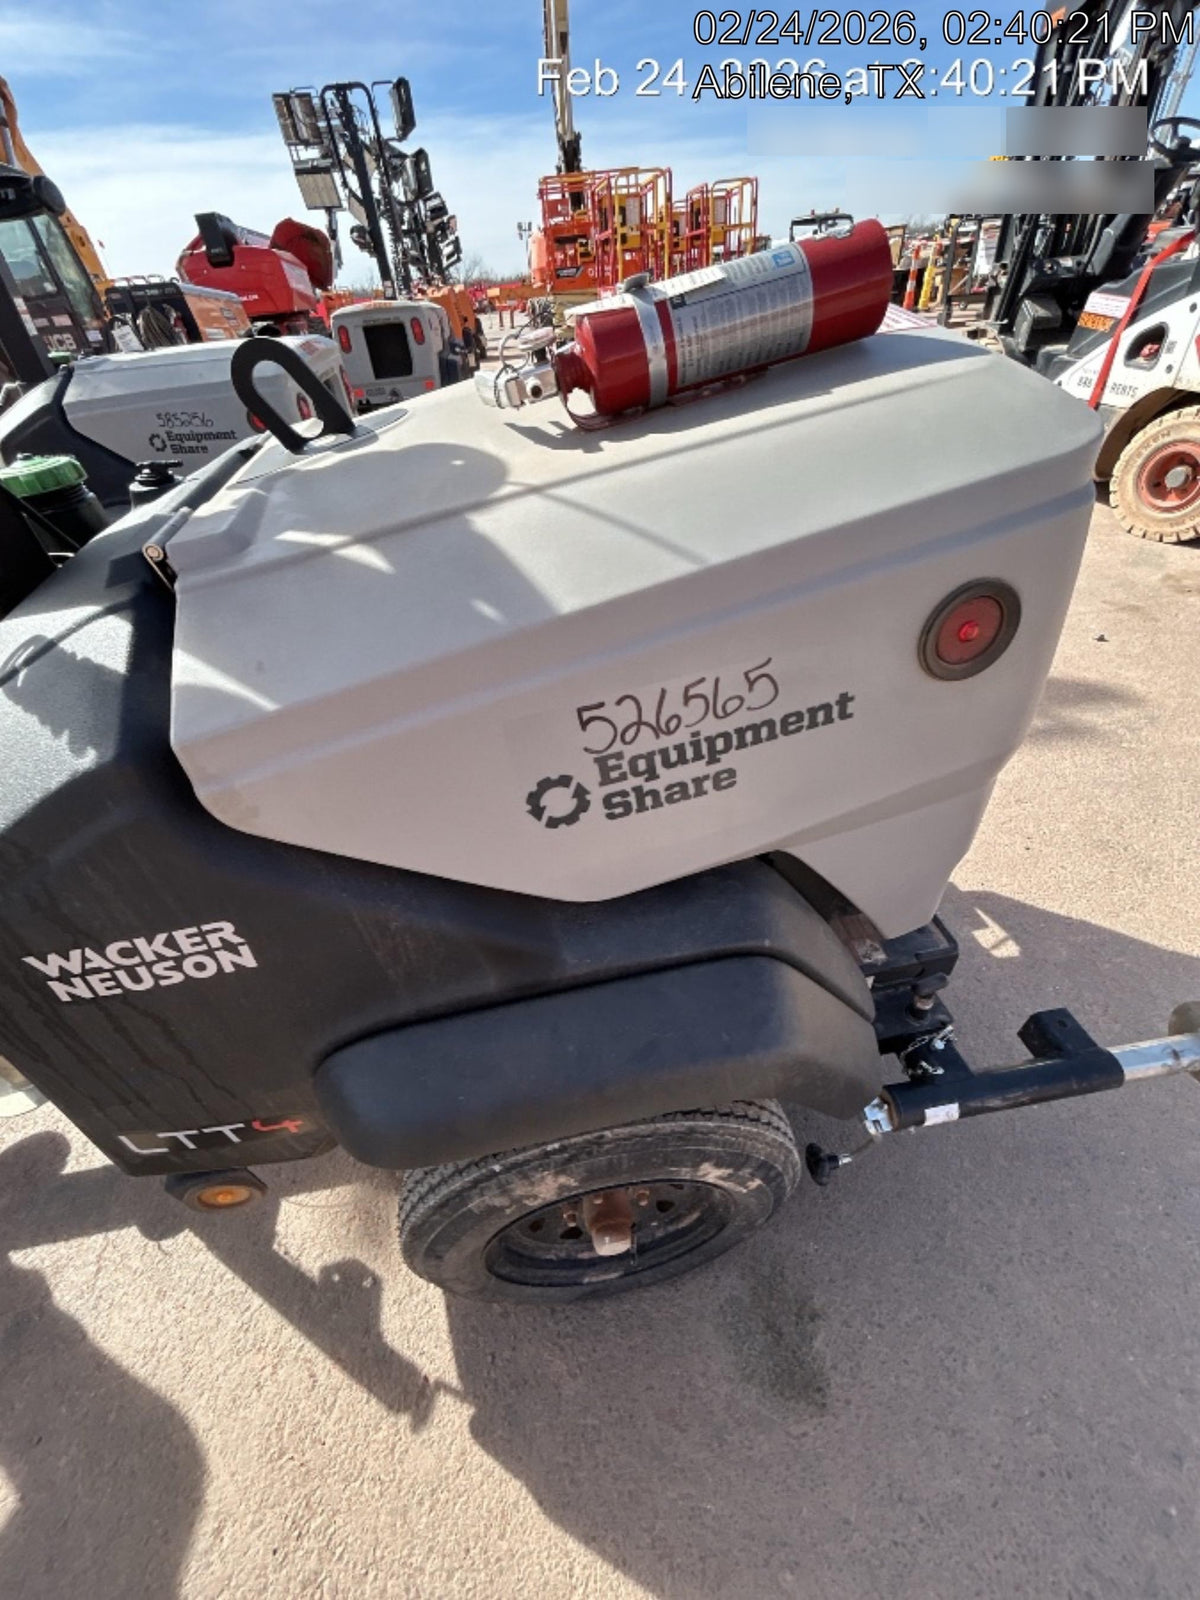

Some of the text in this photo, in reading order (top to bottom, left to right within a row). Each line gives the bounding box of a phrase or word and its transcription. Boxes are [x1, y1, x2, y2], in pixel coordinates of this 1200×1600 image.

[165, 429, 237, 443] Equipment
[170, 444, 208, 454] Share
[576, 657, 780, 754] 526565
[593, 691, 856, 787] Equipment
[602, 767, 738, 820] Share
[21, 920, 246, 979] WACKER
[46, 944, 259, 1002] NEUSON
